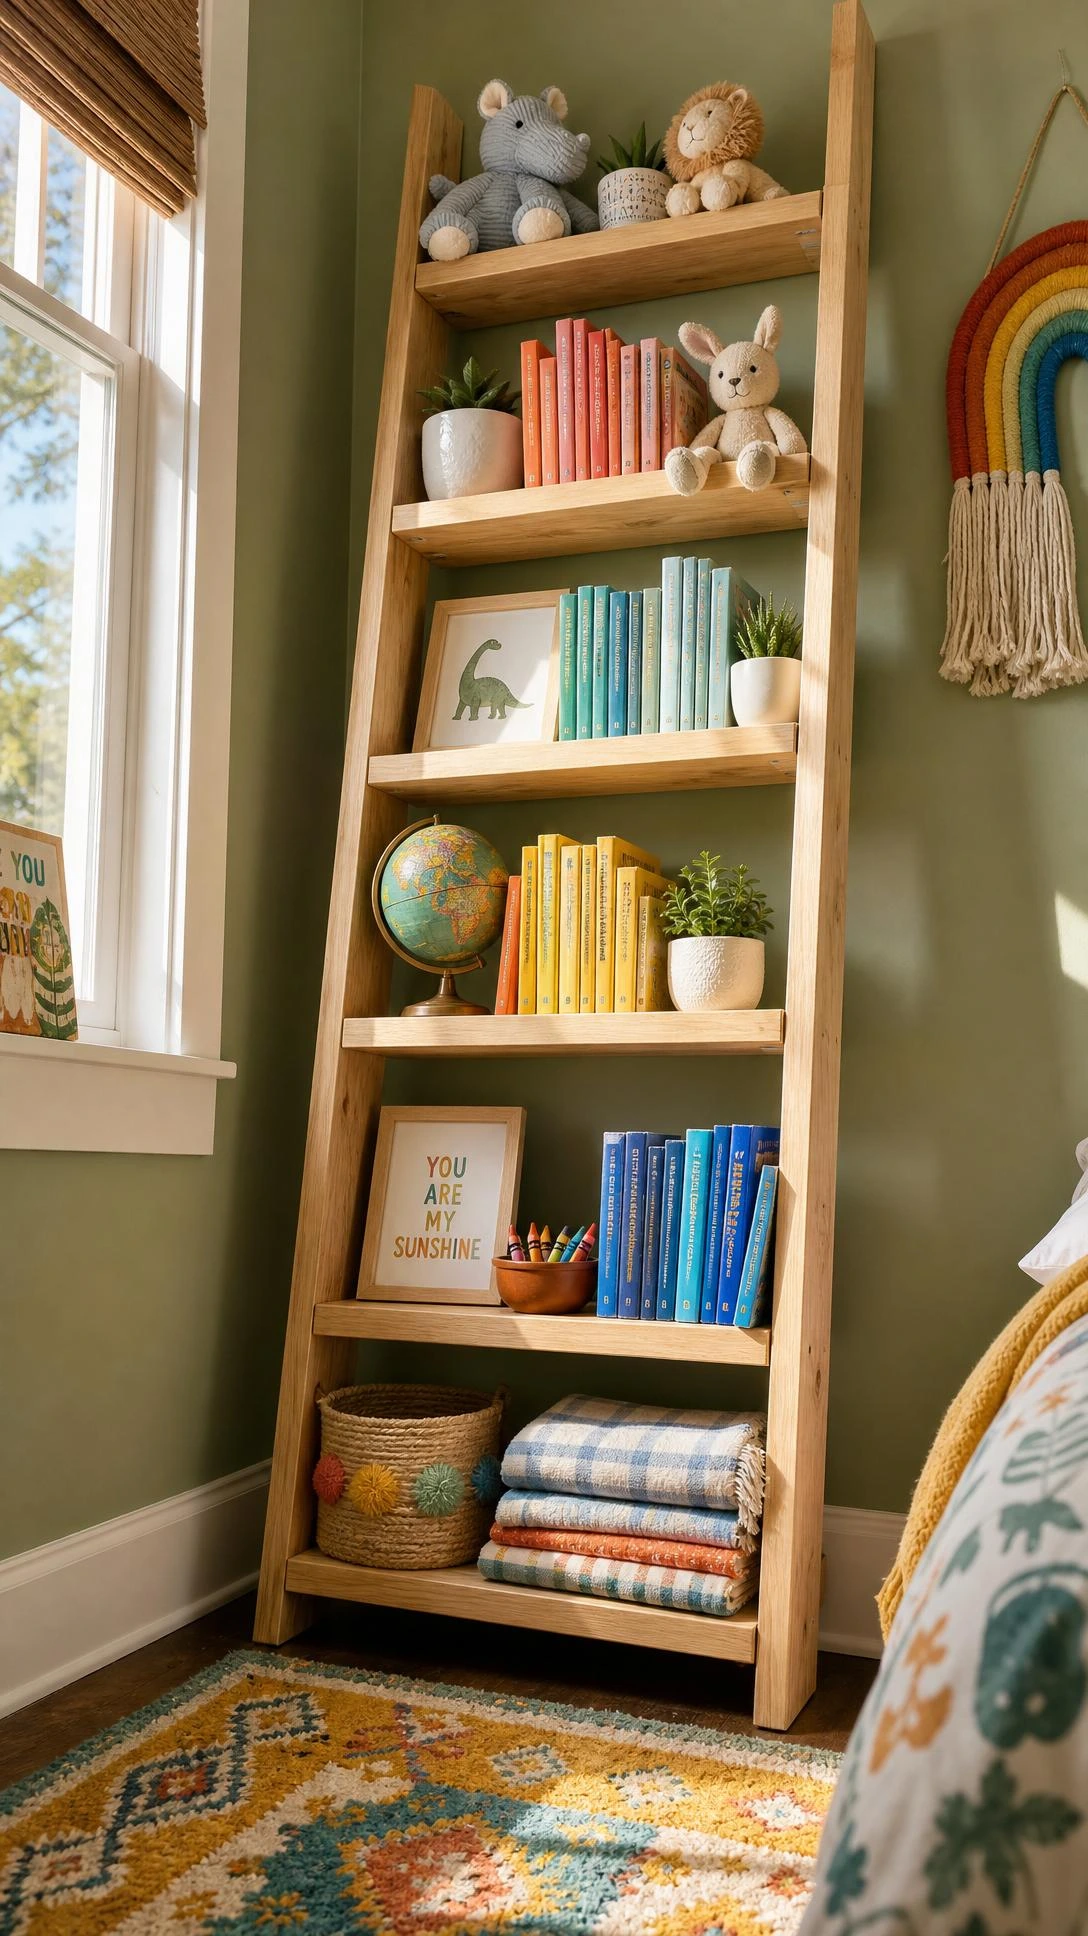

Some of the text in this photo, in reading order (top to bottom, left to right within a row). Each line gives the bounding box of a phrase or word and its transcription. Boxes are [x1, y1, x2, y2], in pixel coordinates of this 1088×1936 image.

[10, 850, 45, 887] YOU
[427, 1156, 467, 1178] YOU
[424, 1183, 463, 1205] ARE
[425, 1210, 456, 1232] MY
[393, 1236, 481, 1260] SUNSHINE
